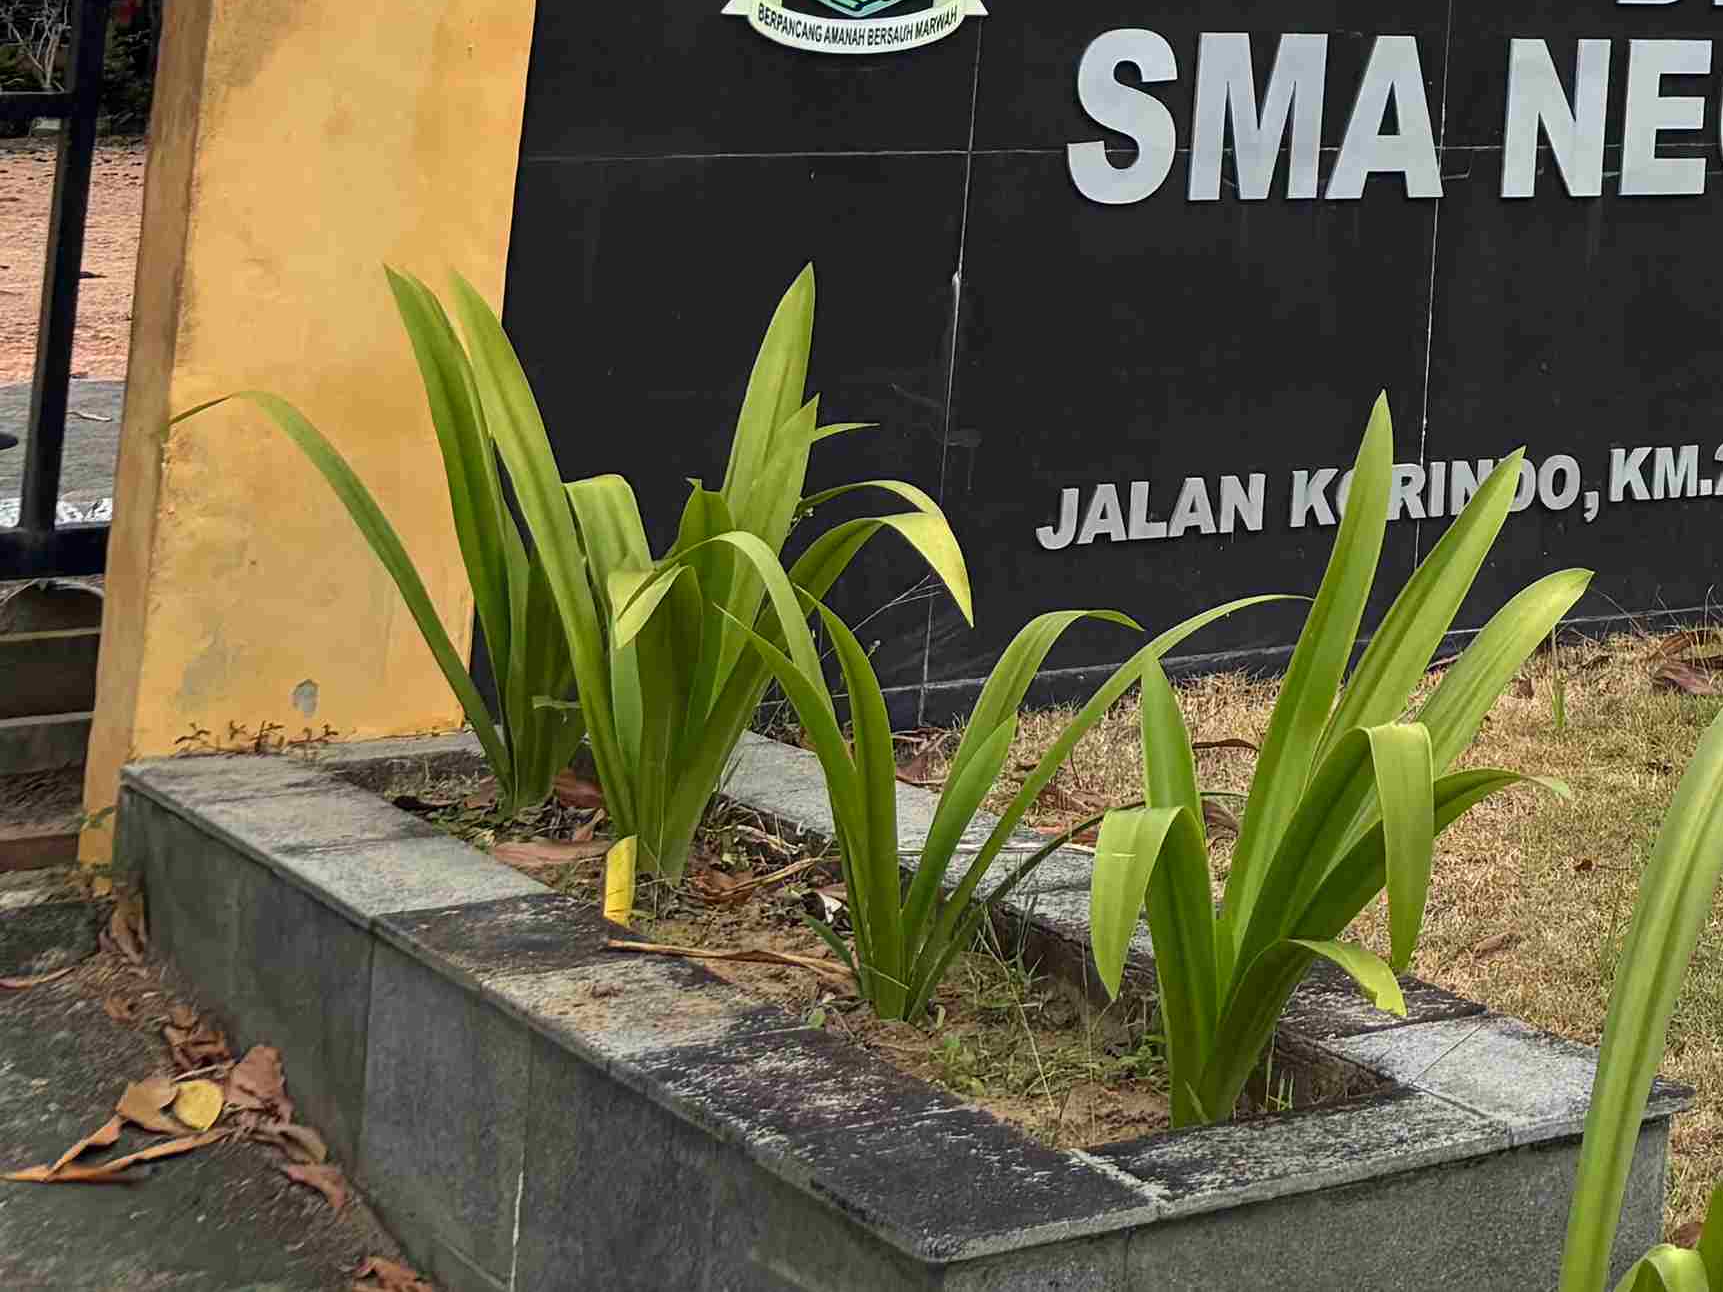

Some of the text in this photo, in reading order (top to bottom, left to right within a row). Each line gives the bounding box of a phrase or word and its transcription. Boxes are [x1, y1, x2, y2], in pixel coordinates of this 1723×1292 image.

[758, 2, 959, 47] BERPANCANG AMANAH BERSAUH MARWAH
[1068, 29, 1443, 204] SMA
[1037, 474, 1265, 549] JALAN
[1290, 453, 1599, 523] KRINDO,
